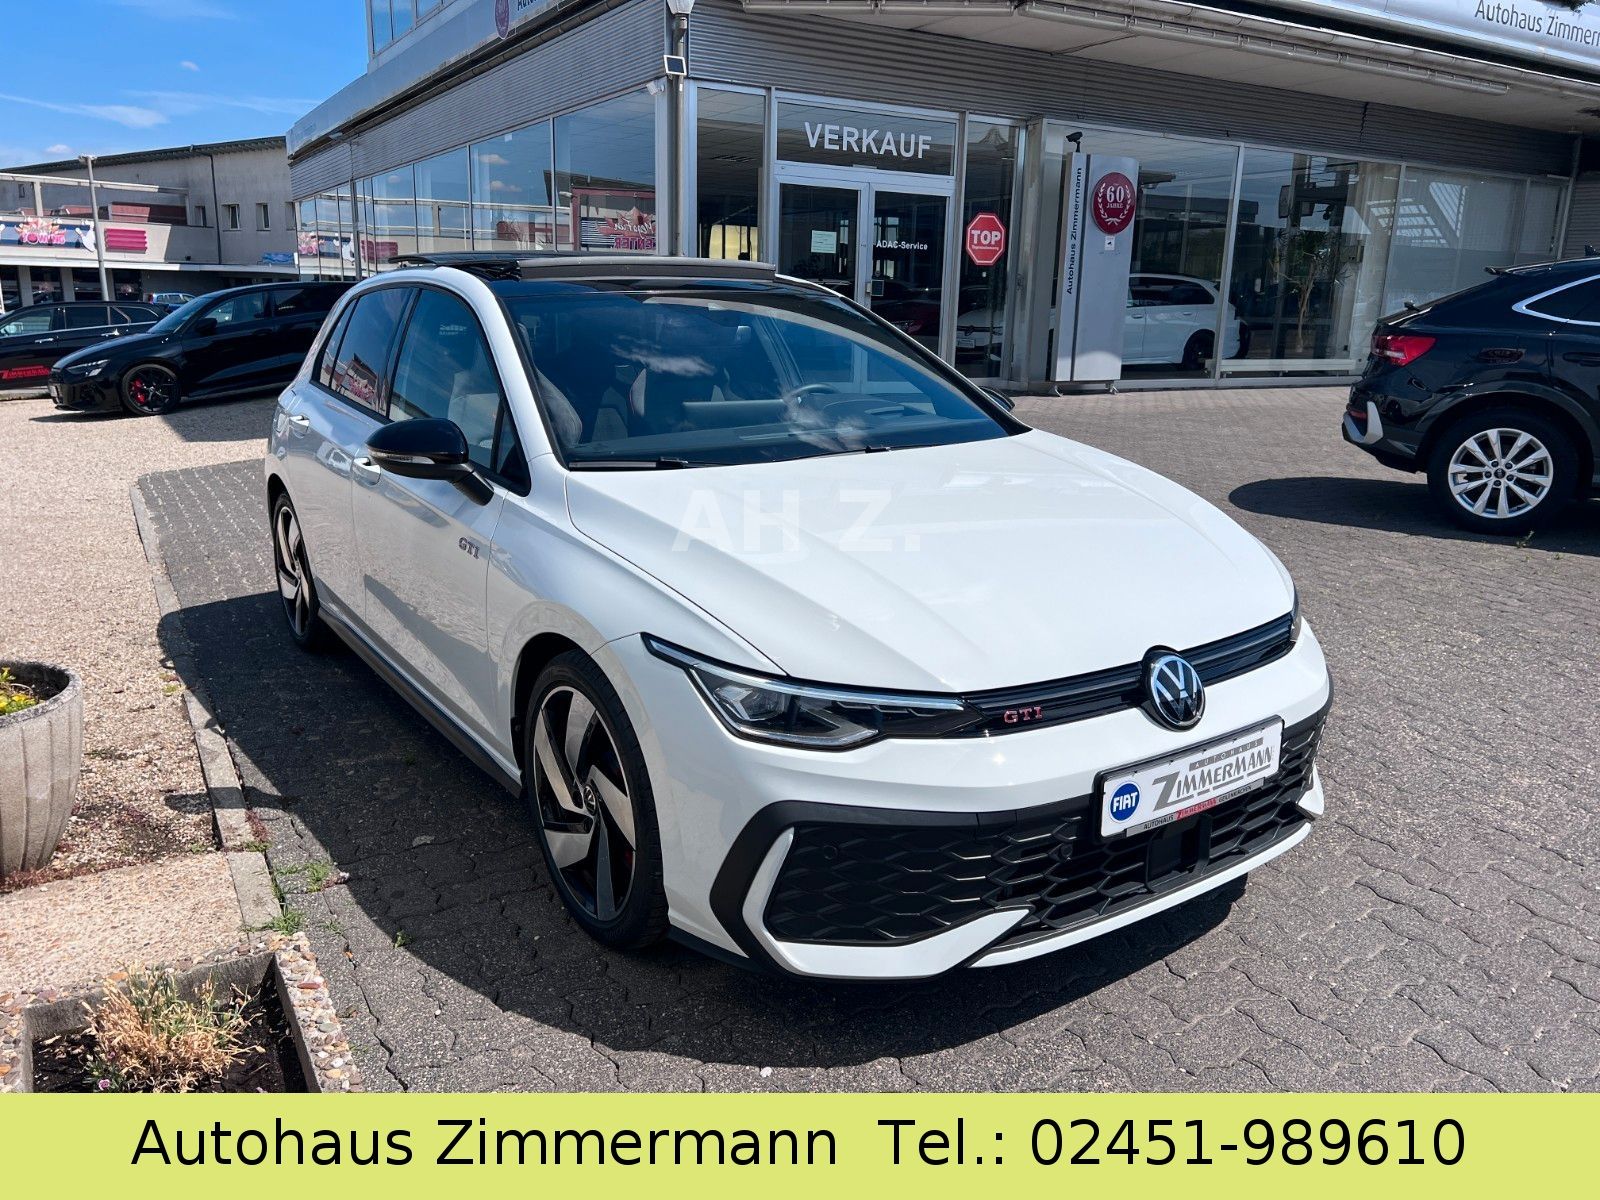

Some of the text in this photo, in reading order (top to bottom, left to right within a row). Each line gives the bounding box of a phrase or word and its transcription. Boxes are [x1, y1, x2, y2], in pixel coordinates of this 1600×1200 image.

[1474, 0, 1543, 33] Autohaus
[804, 121, 932, 159] VERKAUF
[1106, 185, 1125, 203] 60
[971, 230, 1002, 245] TOP
[1066, 167, 1082, 295] Autohaus Zimmermann
[875, 240, 929, 251] ADAC-Service
[458, 536, 480, 560] GTI
[1003, 705, 1044, 725] GTI
[1195, 741, 1259, 768] AUTOHAUS
[1152, 746, 1274, 812] ZIMMERMANN
[1112, 791, 1138, 813] FIAT
[1143, 814, 1174, 830] AUTOHAUS
